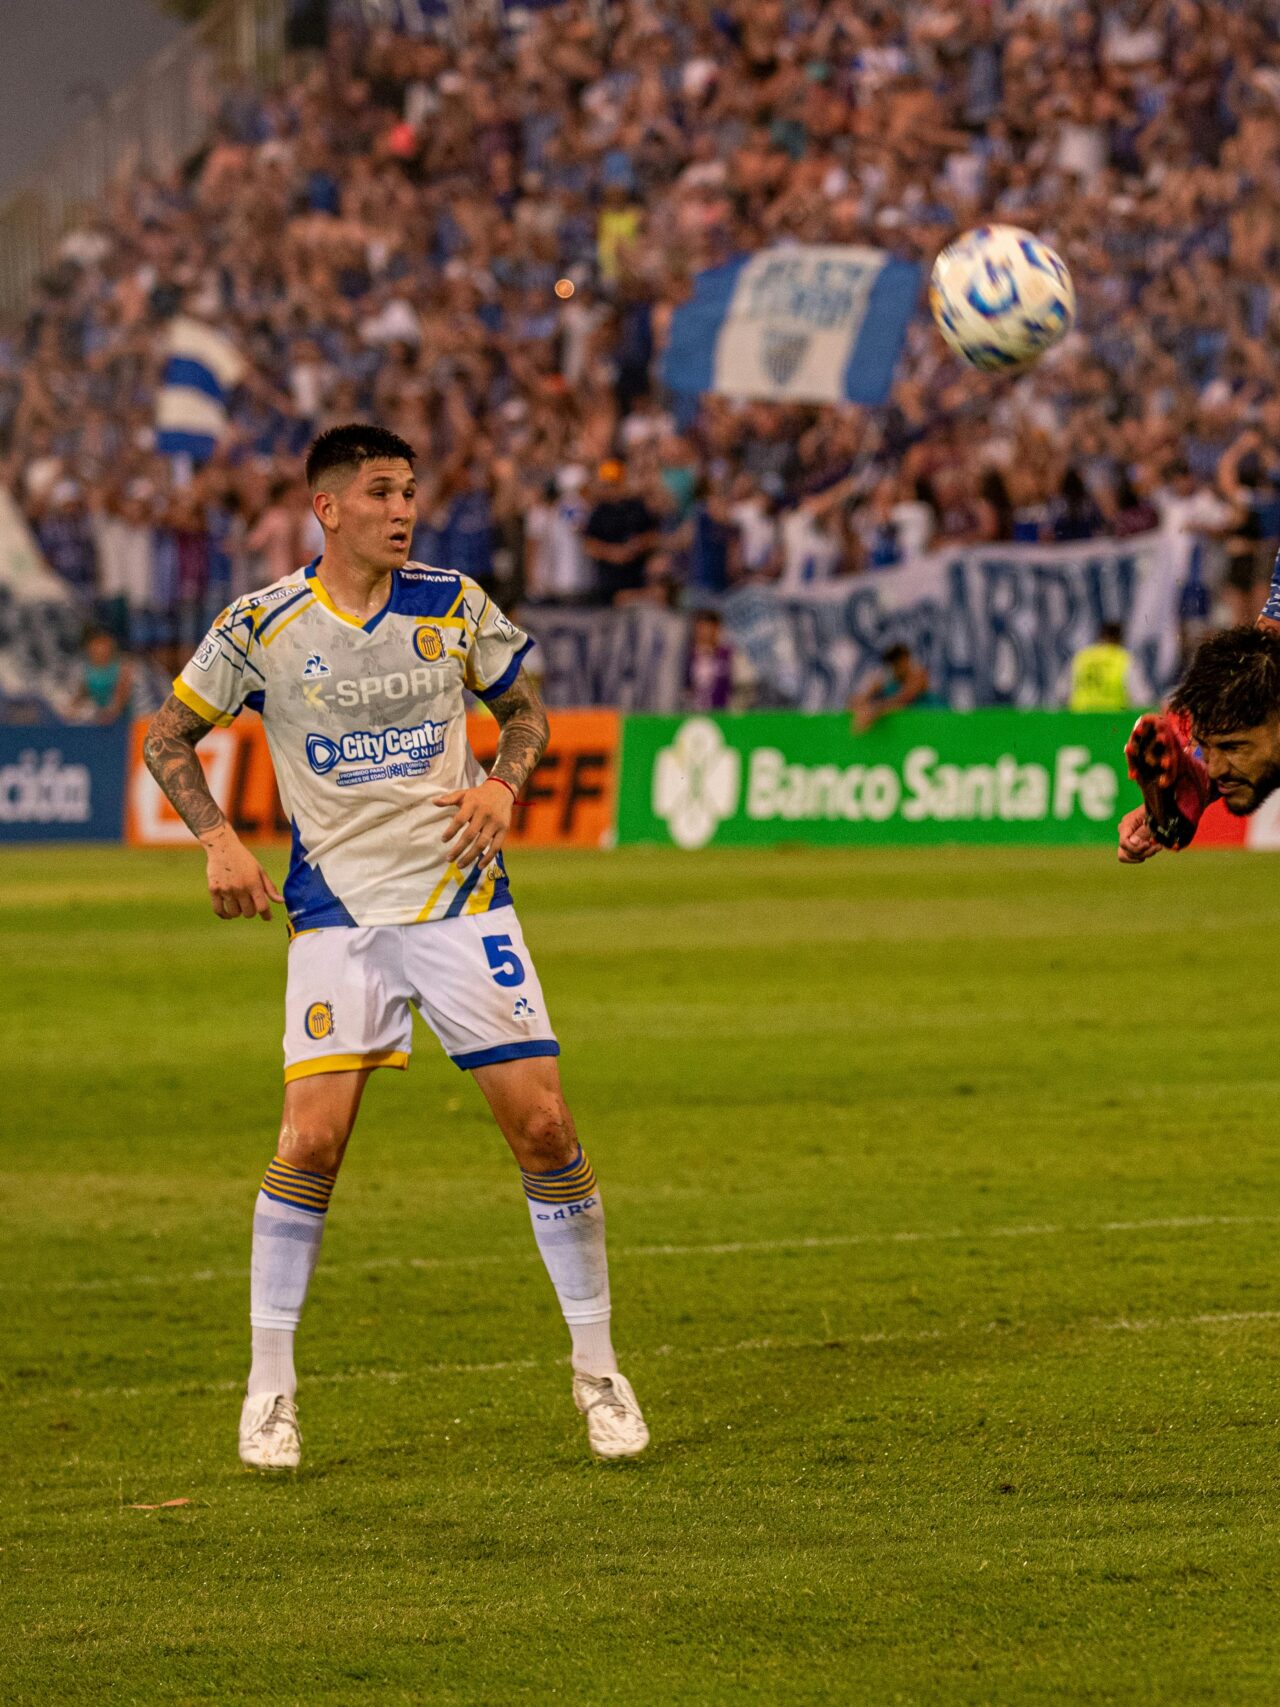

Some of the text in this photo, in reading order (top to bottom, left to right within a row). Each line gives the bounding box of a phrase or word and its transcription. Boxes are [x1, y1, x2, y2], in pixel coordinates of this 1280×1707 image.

[303, 668, 450, 711] K-SPORT
[411, 743, 444, 758] ONLINE
[336, 775, 362, 786] MENORES
[340, 769, 369, 779] PROHIBIDO
[748, 745, 1119, 821] Banco Santa Fe
[482, 934, 525, 987] 5
